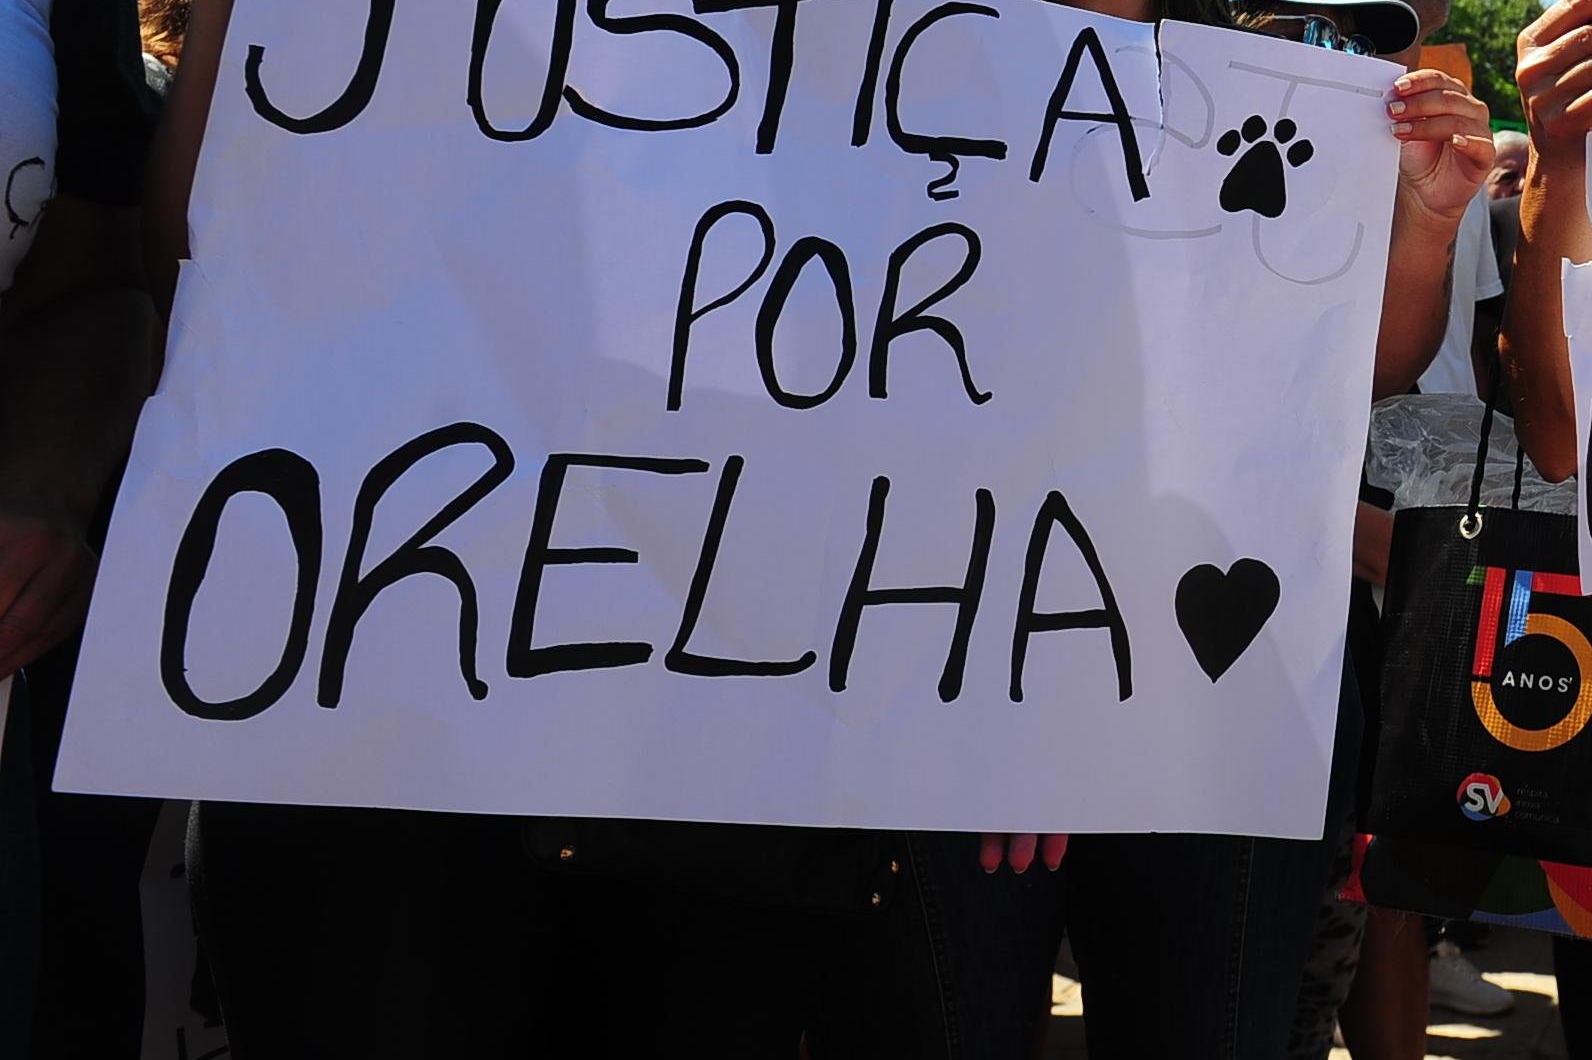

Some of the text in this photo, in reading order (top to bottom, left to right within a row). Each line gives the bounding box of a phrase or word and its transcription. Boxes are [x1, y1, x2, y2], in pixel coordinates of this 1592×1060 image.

[666, 199, 993, 412] POR
[159, 421, 1134, 722] ORELHA
[1464, 782, 1505, 814] SV
